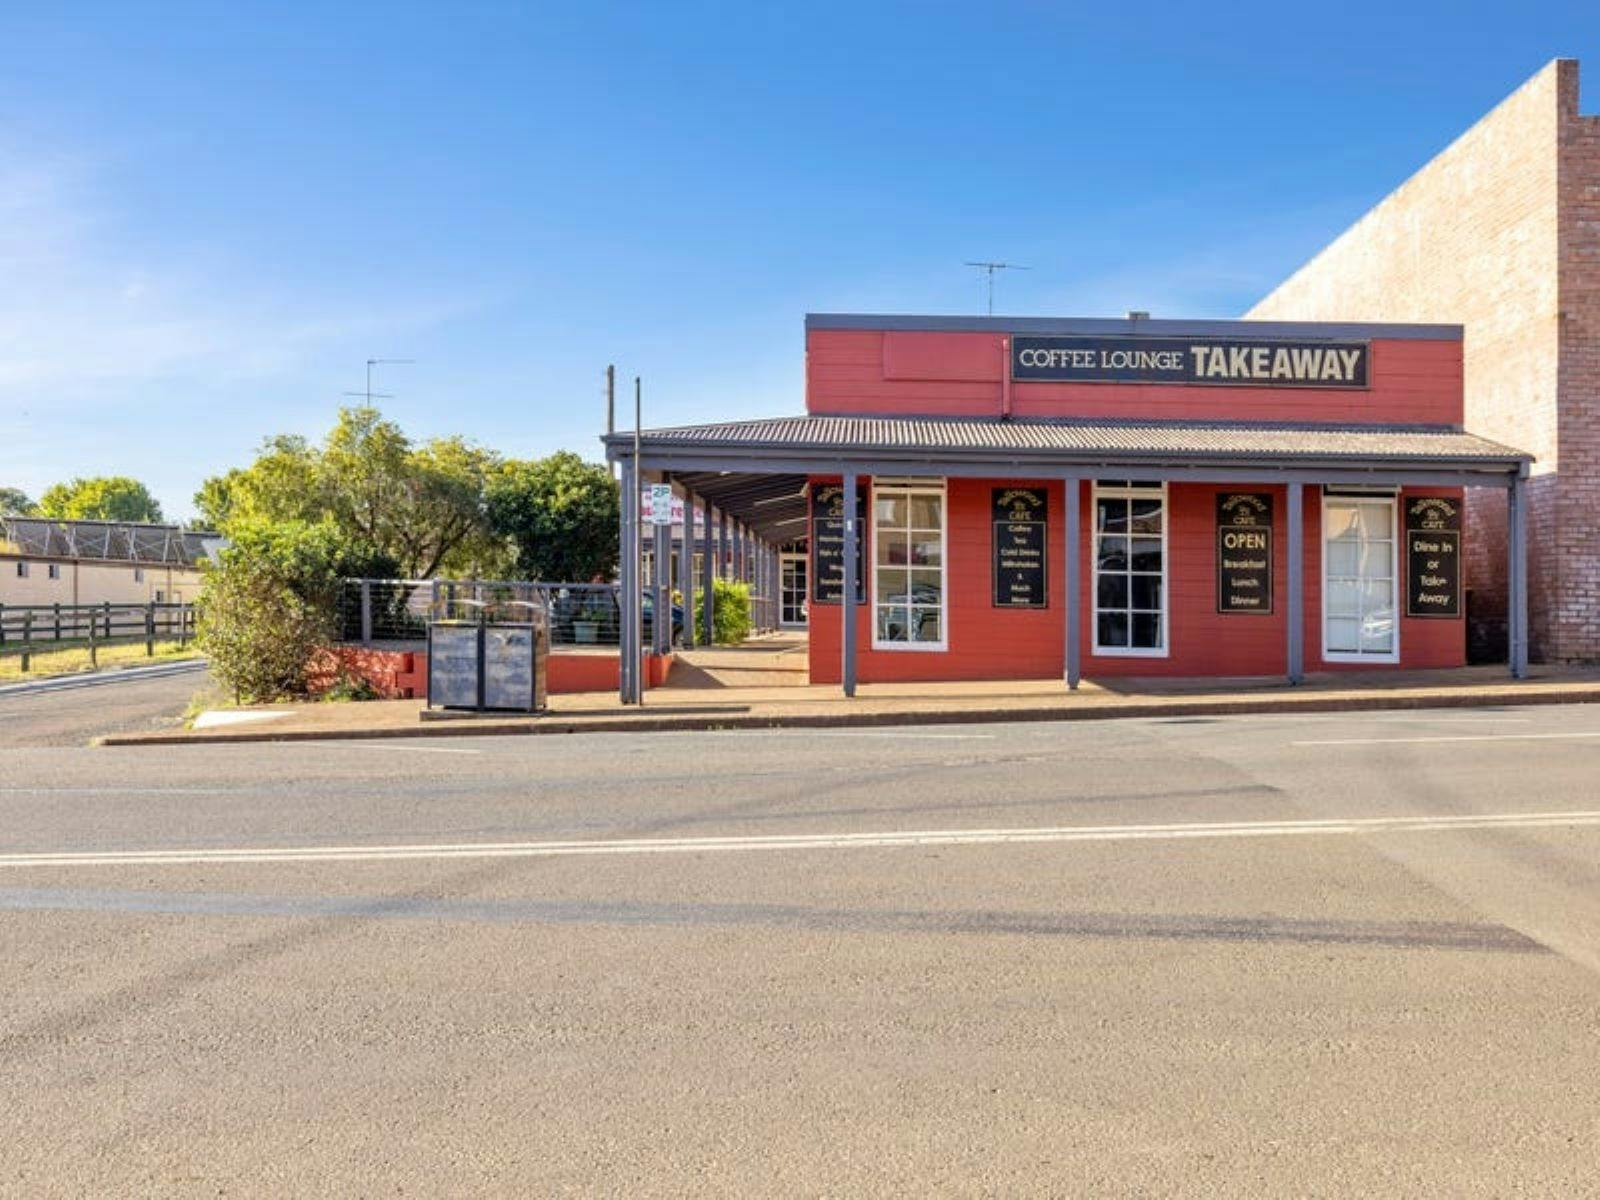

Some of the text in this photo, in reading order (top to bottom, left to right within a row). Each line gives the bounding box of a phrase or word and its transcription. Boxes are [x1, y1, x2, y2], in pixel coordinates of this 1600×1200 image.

[1019, 349, 1184, 370] COFFEE LOUNGE
[1191, 346, 1360, 380] TAKEAWAY
[1224, 532, 1266, 549] OPEN
[1413, 541, 1439, 552] Dine
[1427, 561, 1440, 570] or
[1231, 577, 1259, 587] Lunch
[1231, 595, 1260, 605] Dinner
[1419, 593, 1450, 606] Away
